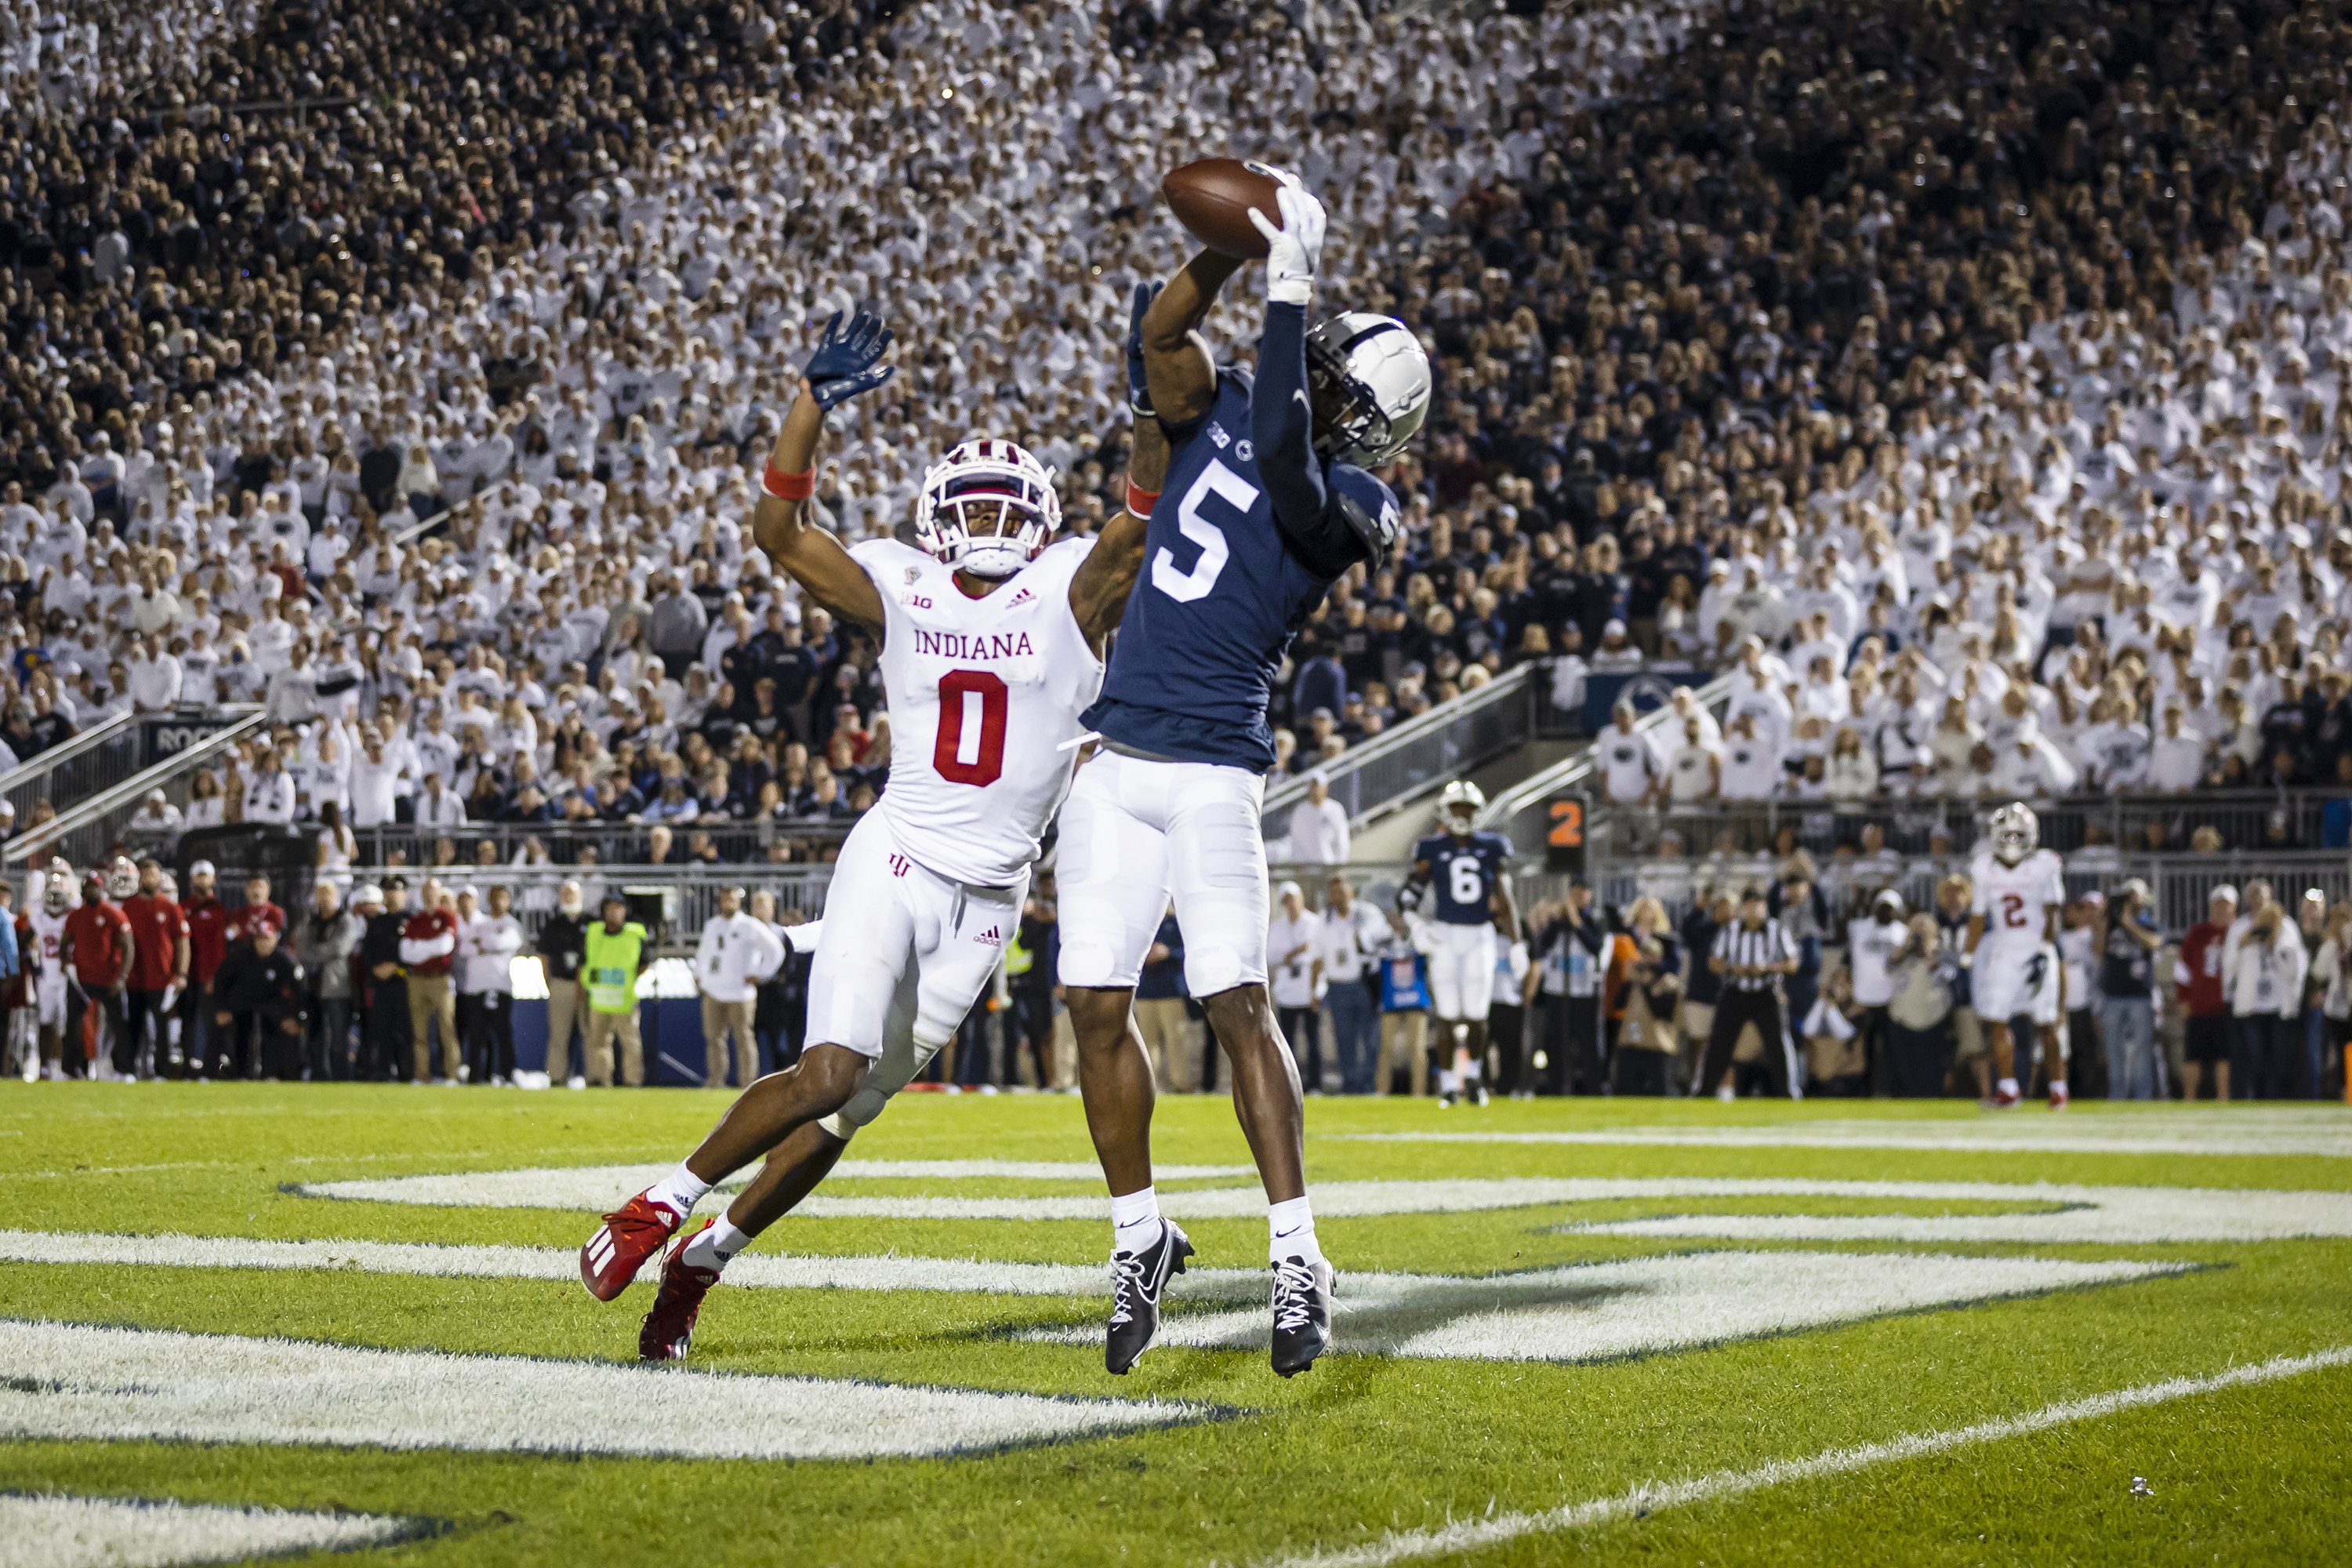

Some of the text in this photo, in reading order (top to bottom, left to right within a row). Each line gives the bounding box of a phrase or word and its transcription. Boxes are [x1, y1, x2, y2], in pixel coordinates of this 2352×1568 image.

[1152, 457, 1260, 603] 5
[915, 629, 1034, 660] INDIANA
[933, 669, 1008, 788] 0
[1549, 800, 1581, 846] 2
[1450, 855, 1483, 905] 6
[2001, 895, 2027, 928] 2
